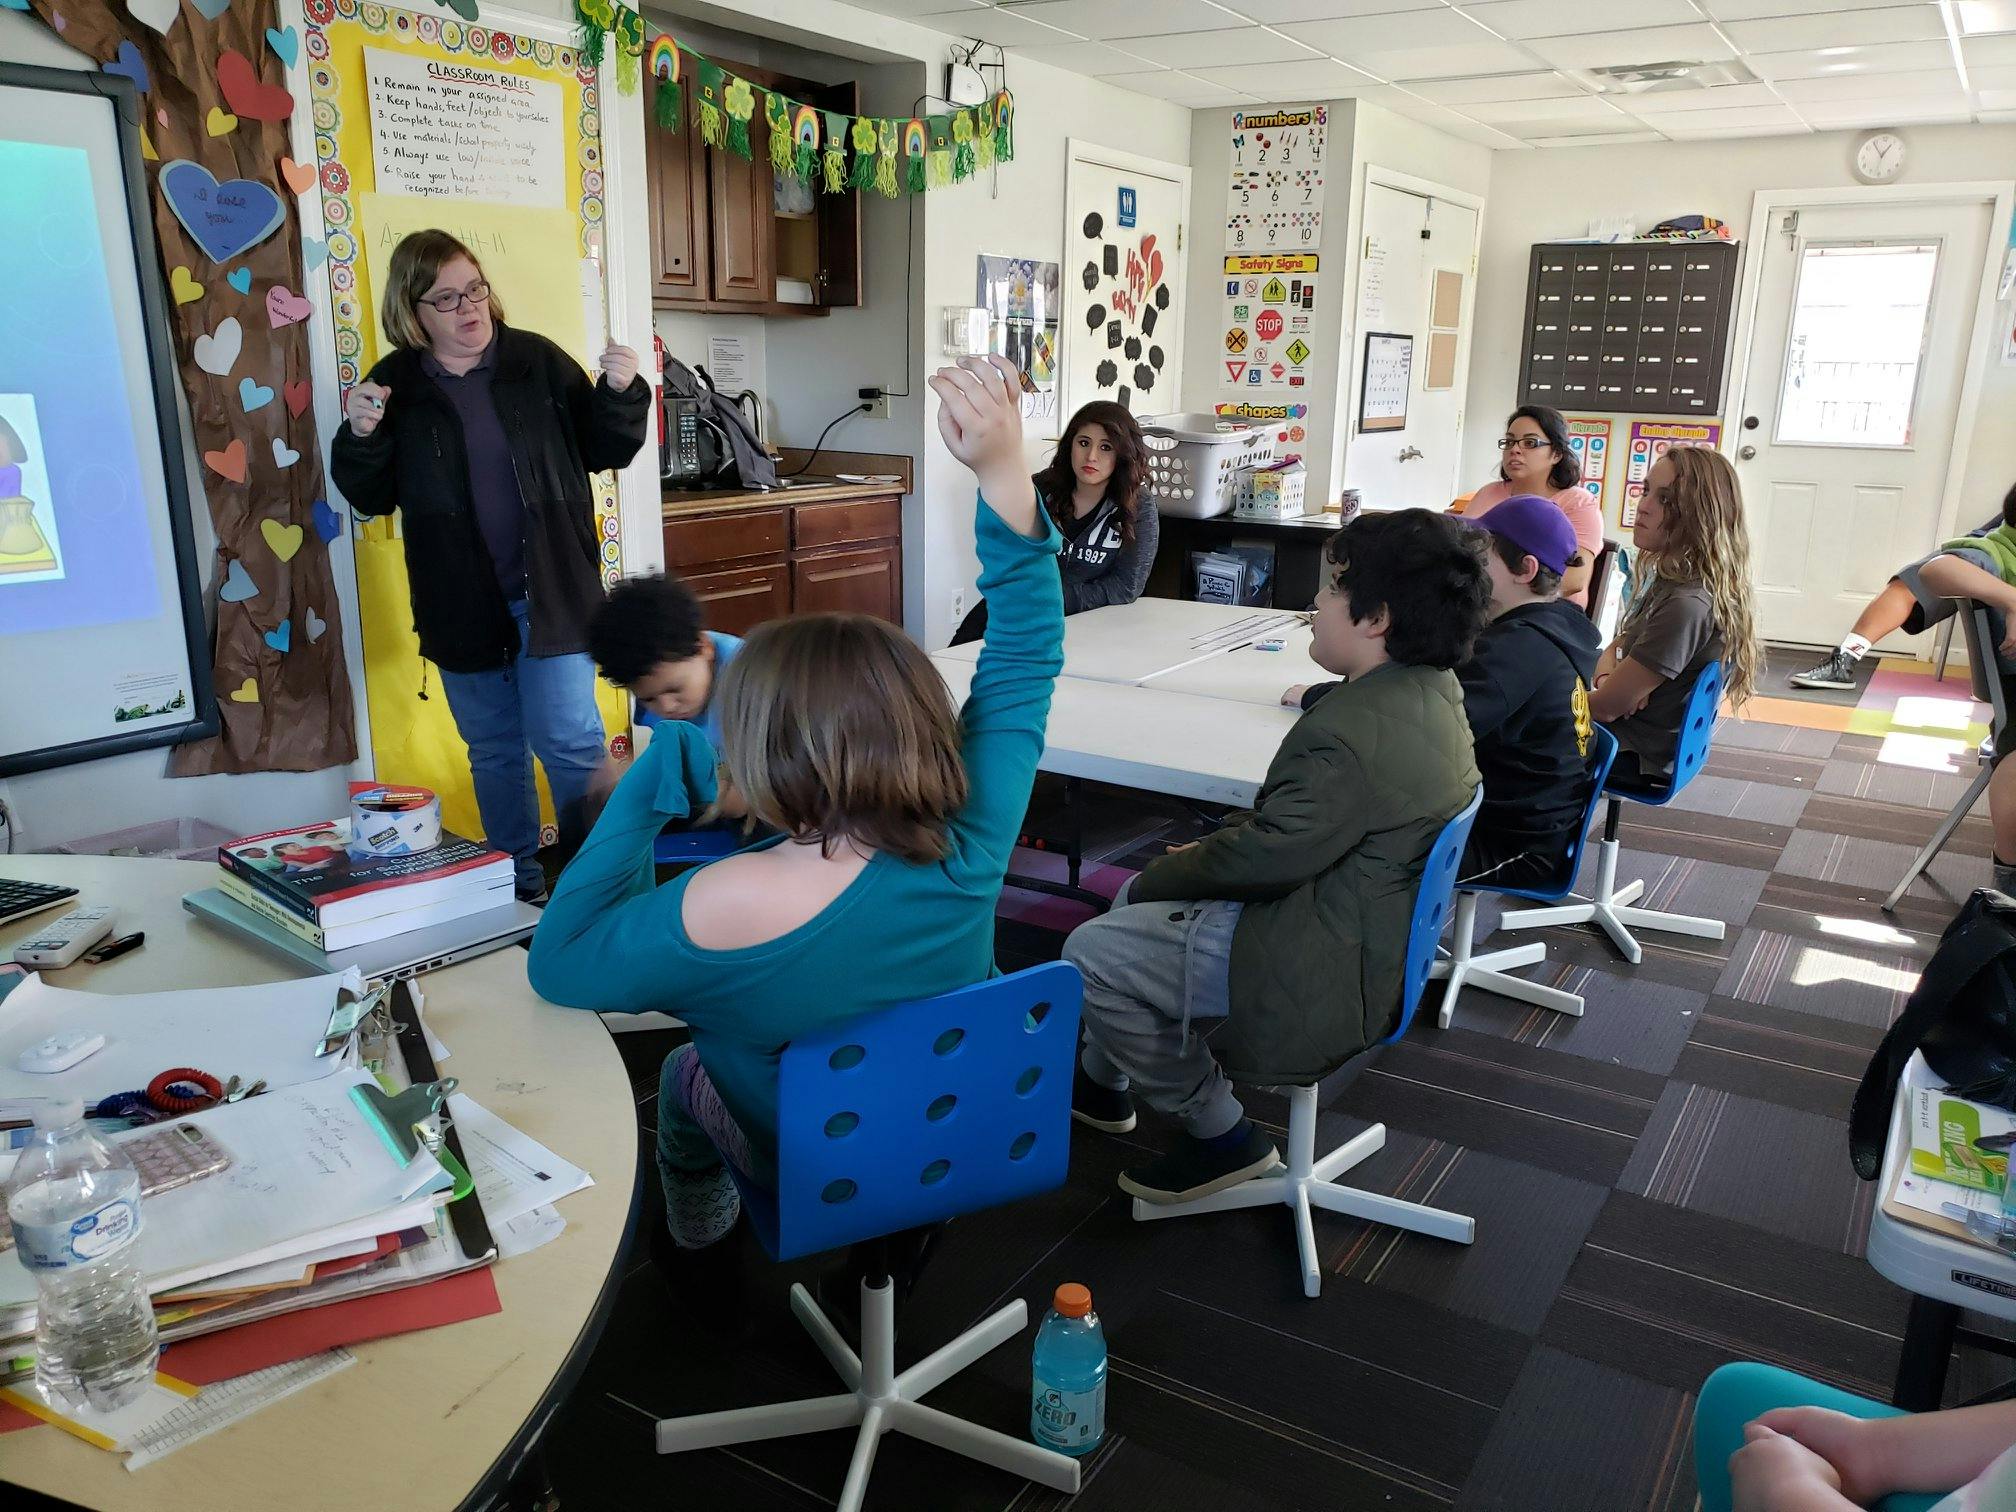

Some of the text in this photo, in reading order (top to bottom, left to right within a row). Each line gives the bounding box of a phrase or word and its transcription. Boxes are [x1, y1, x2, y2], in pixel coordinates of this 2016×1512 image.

[427, 62, 530, 89] CLASSROOM RULES
[384, 77, 420, 91] Remain
[427, 86, 436, 94] in
[441, 87, 462, 97] your
[469, 92, 507, 103] assigned
[387, 94, 410, 109] Keep
[391, 113, 433, 127] Complete
[439, 118, 462, 128] tasks
[1246, 111, 1311, 128] numbers
[380, 130, 389, 139] 4.
[393, 131, 407, 140] Use
[414, 132, 451, 144] materials
[394, 147, 429, 164] Always
[1259, 150, 1266, 161] 2
[1283, 148, 1290, 160] 3
[1312, 147, 1320, 158] 4
[396, 167, 420, 179] Raise
[429, 173, 446, 183] your
[451, 167, 474, 182] hand
[405, 185, 449, 197] recognized
[1242, 189, 1312, 203] 5 6 7
[1237, 229, 1311, 241] 8 9 10
[1240, 258, 1303, 271] Safety Signs
[1257, 319, 1282, 331] STOP
[1237, 404, 1287, 418] shapes
[1077, 548, 1107, 564] 1987
[370, 828, 397, 845] Scotch
[291, 842, 471, 886] The Curriculum
[383, 850, 487, 876] Professionals
[1035, 1399, 1076, 1425] ZERO
